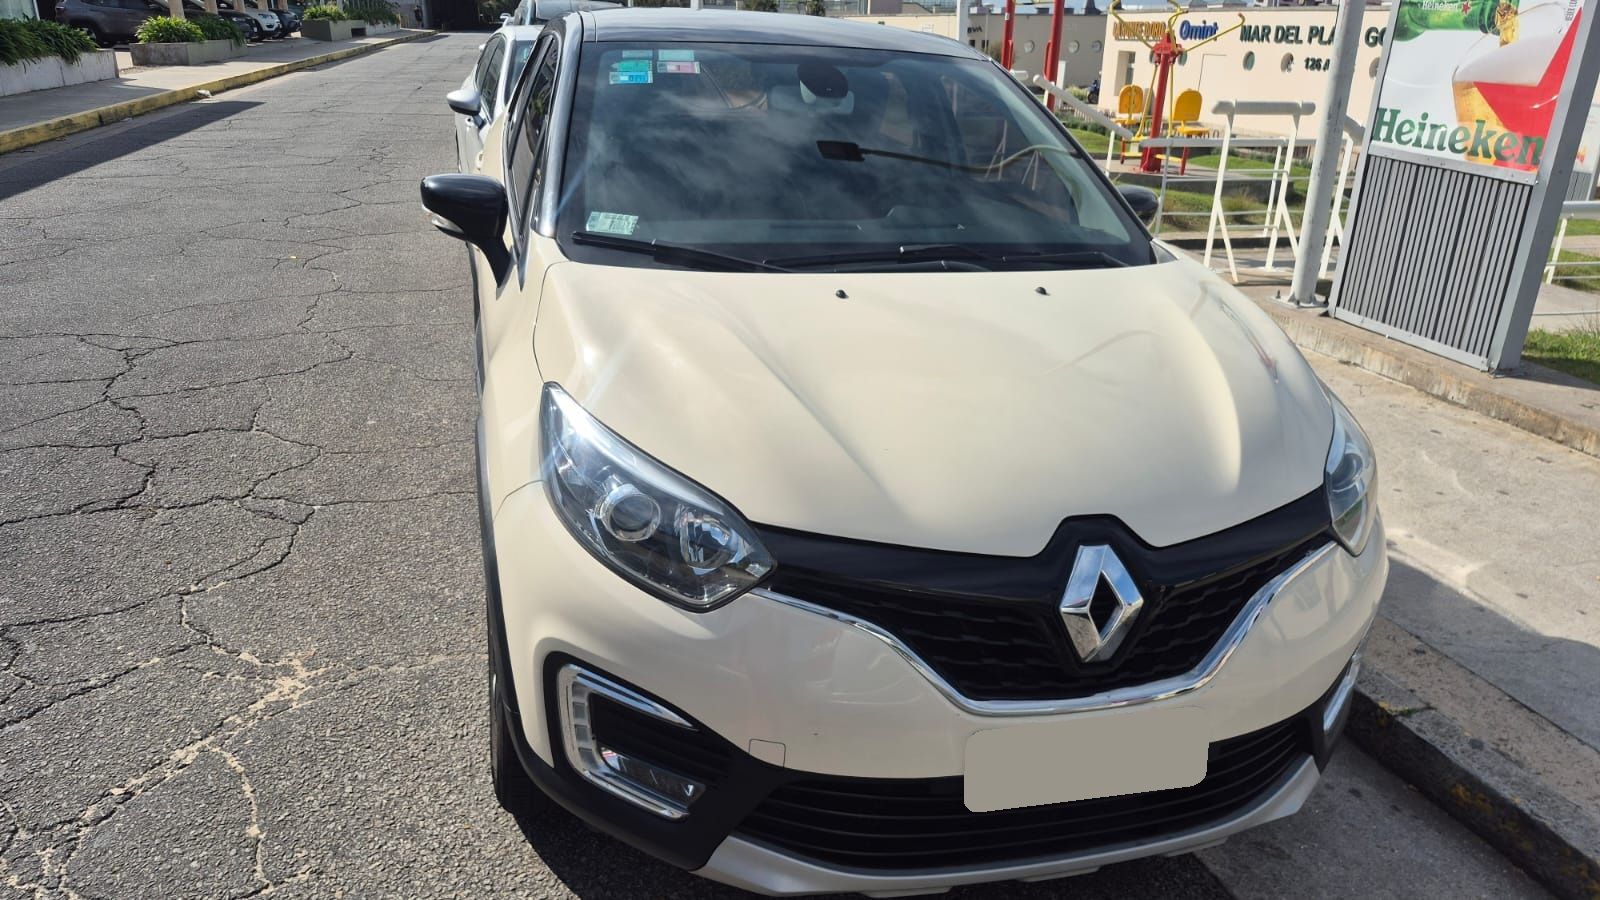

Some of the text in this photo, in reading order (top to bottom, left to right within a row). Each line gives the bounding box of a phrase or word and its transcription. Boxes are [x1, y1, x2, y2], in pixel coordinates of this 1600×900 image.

[1180, 20, 1218, 41] Omint
[1240, 25, 1271, 43] MAR
[1274, 25, 1303, 44] DEL
[1308, 25, 1335, 46] PLA
[1372, 107, 1544, 166] Heineken
